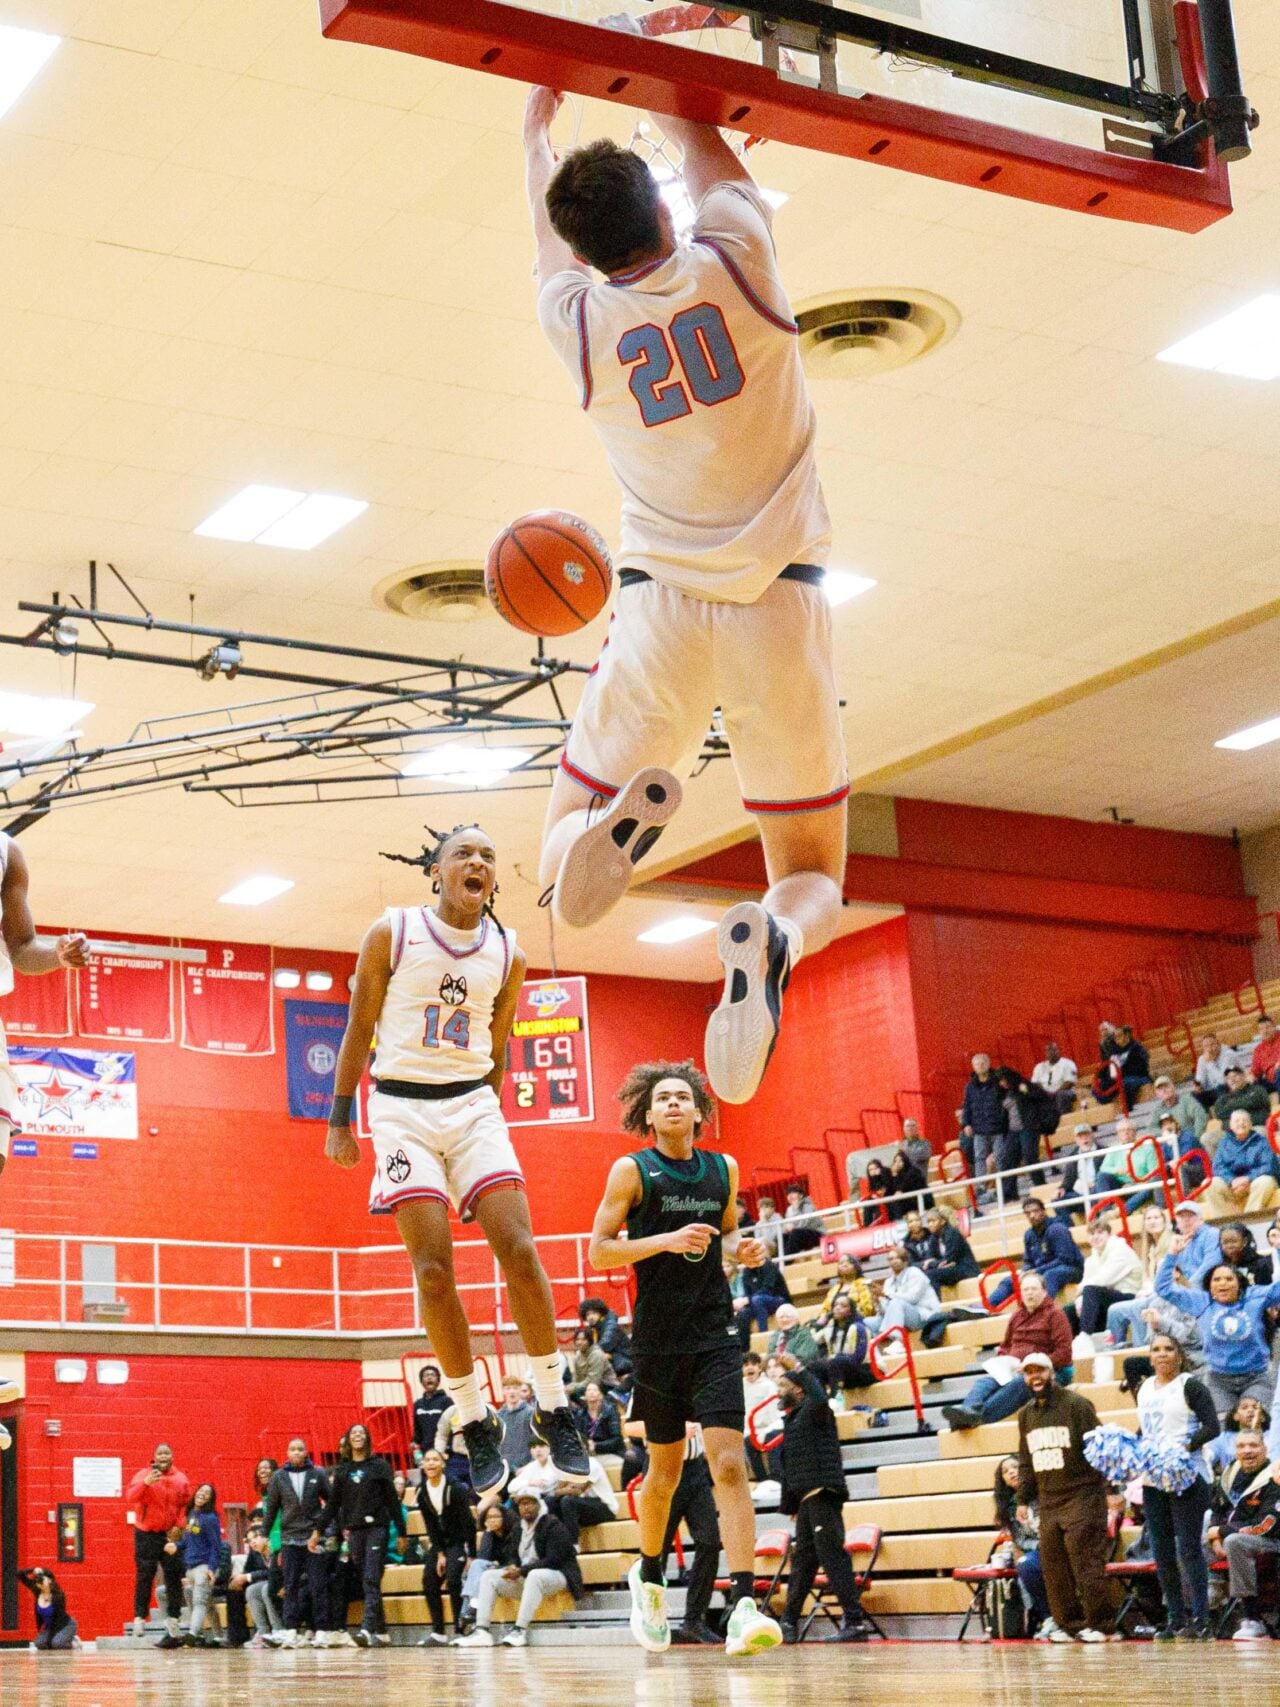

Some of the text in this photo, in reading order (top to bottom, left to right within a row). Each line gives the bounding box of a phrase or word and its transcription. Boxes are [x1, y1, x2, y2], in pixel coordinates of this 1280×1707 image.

[617, 301, 746, 427] 20
[103, 957, 164, 969] CHAMPIONSHIPS
[222, 950, 234, 968] P
[187, 967, 265, 980] NLC CHAMPIONSHIPS
[422, 1004, 471, 1051] 14
[513, 1016, 580, 1037] WASHINGTON
[534, 1036, 573, 1068] 69
[546, 1068, 578, 1080] FOULS
[517, 1081, 575, 1108] 2 4
[548, 1107, 580, 1119] SCORE
[26, 1123, 85, 1134] PLYMOUTH
